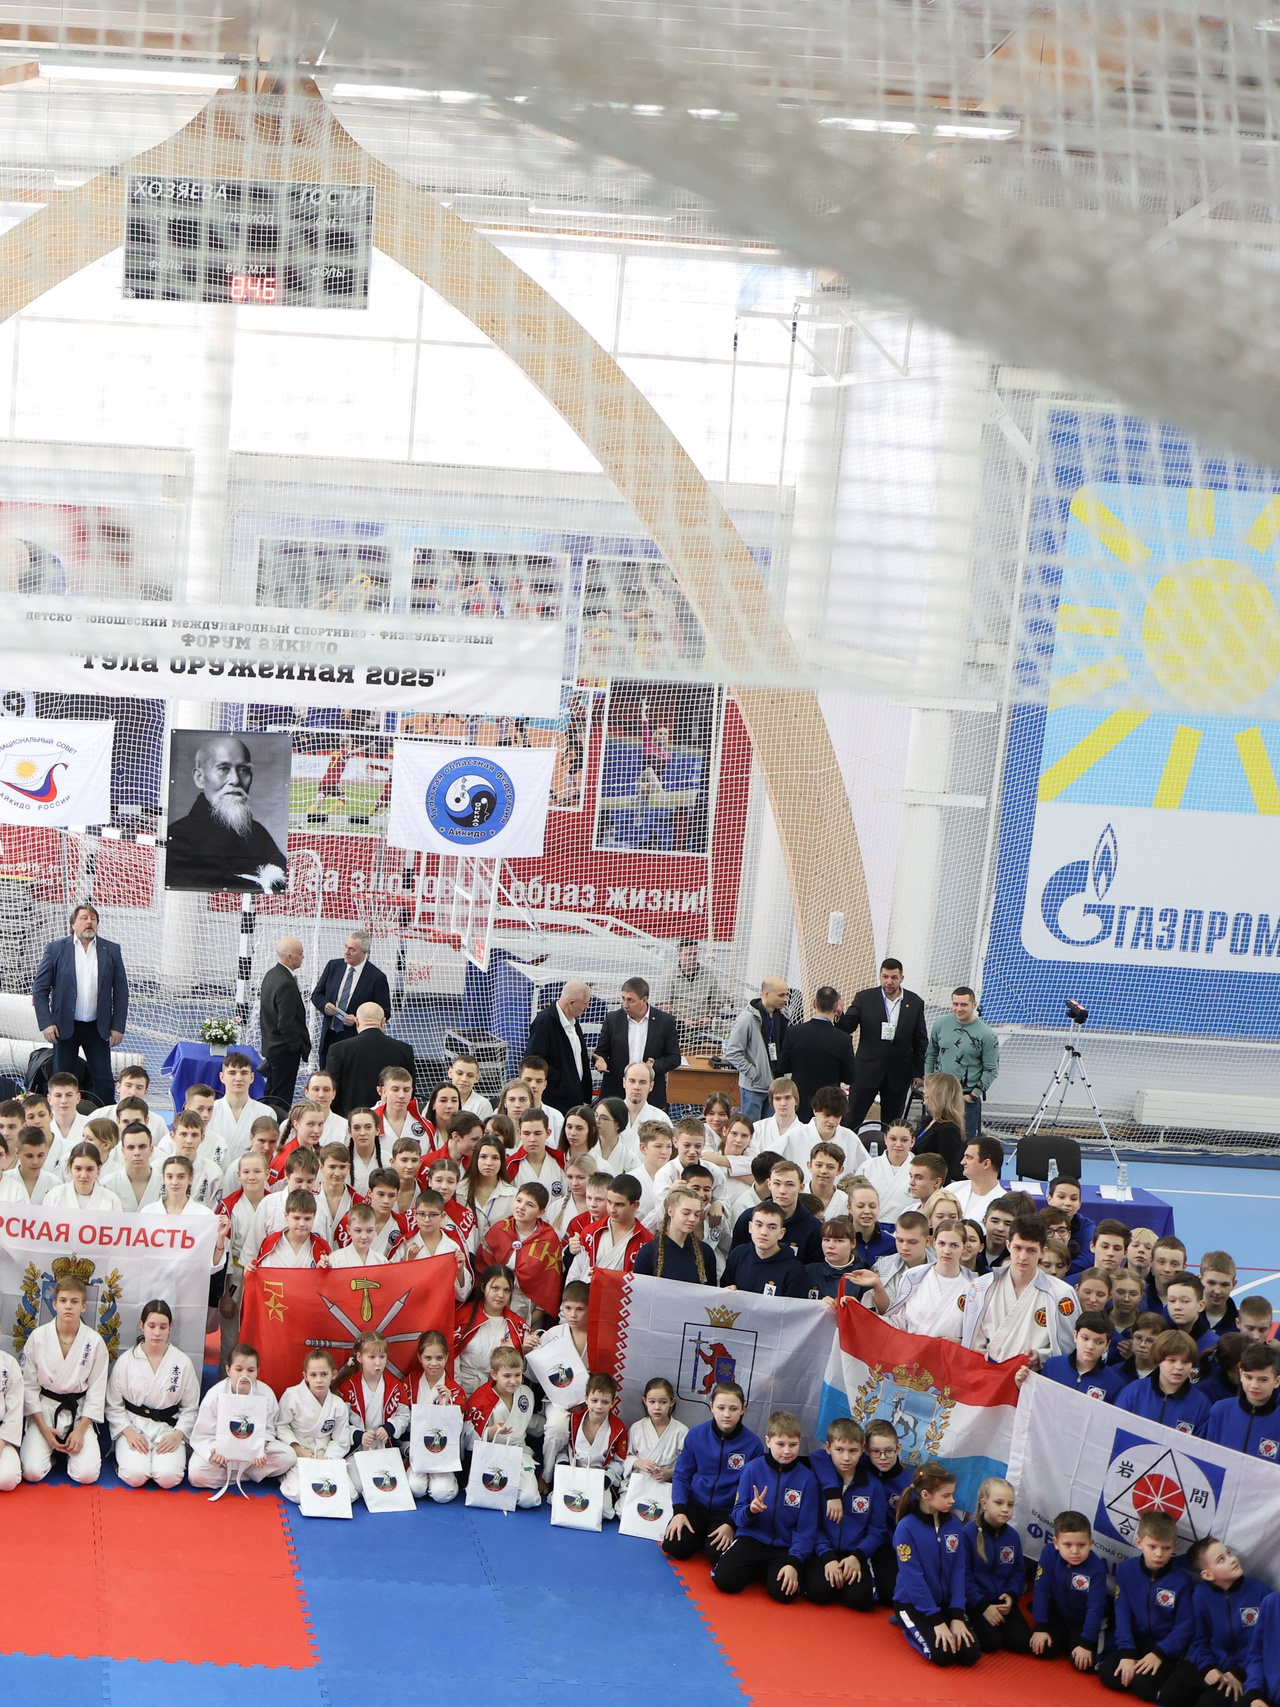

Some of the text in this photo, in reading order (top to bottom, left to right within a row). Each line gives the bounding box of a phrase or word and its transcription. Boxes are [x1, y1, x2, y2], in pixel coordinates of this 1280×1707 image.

[134, 181, 367, 208] ХОЗЯЕВА ГОСТИ
[366, 666, 447, 688] 2025"
[56, 741, 78, 755] СОВЕТ
[38, 795, 72, 811] РОССИИ
[448, 828, 487, 838] Айкидо
[510, 875, 596, 909] образ
[606, 885, 706, 913] жизни!
[1114, 905, 1280, 958] ГАЗПРОМ
[78, 1223, 195, 1249] ОБЛАСТЬ
[1189, 1487, 1209, 1509] 間
[1117, 1517, 1136, 1536] 合
